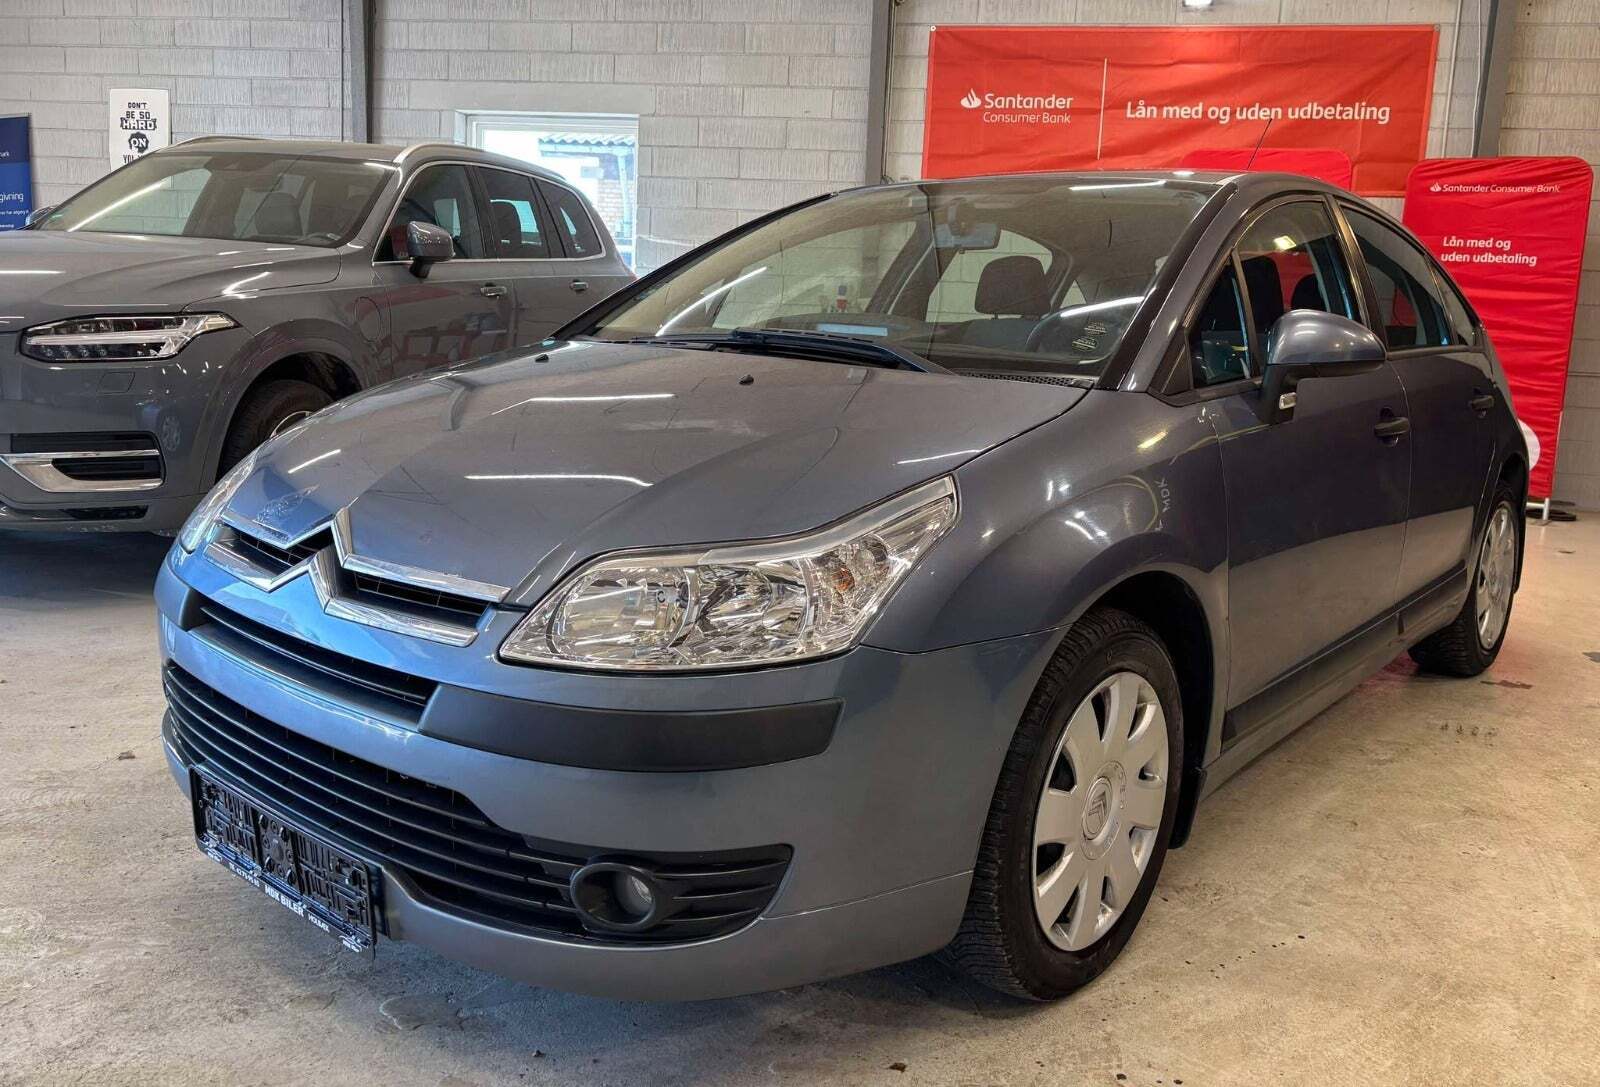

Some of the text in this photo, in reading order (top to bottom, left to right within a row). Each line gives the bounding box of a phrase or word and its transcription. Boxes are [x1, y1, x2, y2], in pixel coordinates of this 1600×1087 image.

[984, 93, 1074, 109] Santander
[126, 110, 151, 120] BE SO
[983, 112, 1071, 124] Consumer Bank
[1126, 100, 1390, 125] Lån med og uden udbetaling
[122, 119, 155, 130] HARD
[131, 138, 147, 148] ON
[1442, 183, 1560, 193] Santander Consumer Bank
[1443, 235, 1511, 251] Lån med og
[1441, 251, 1538, 267] uden udbetaling
[281, 893, 305, 918] BILER
